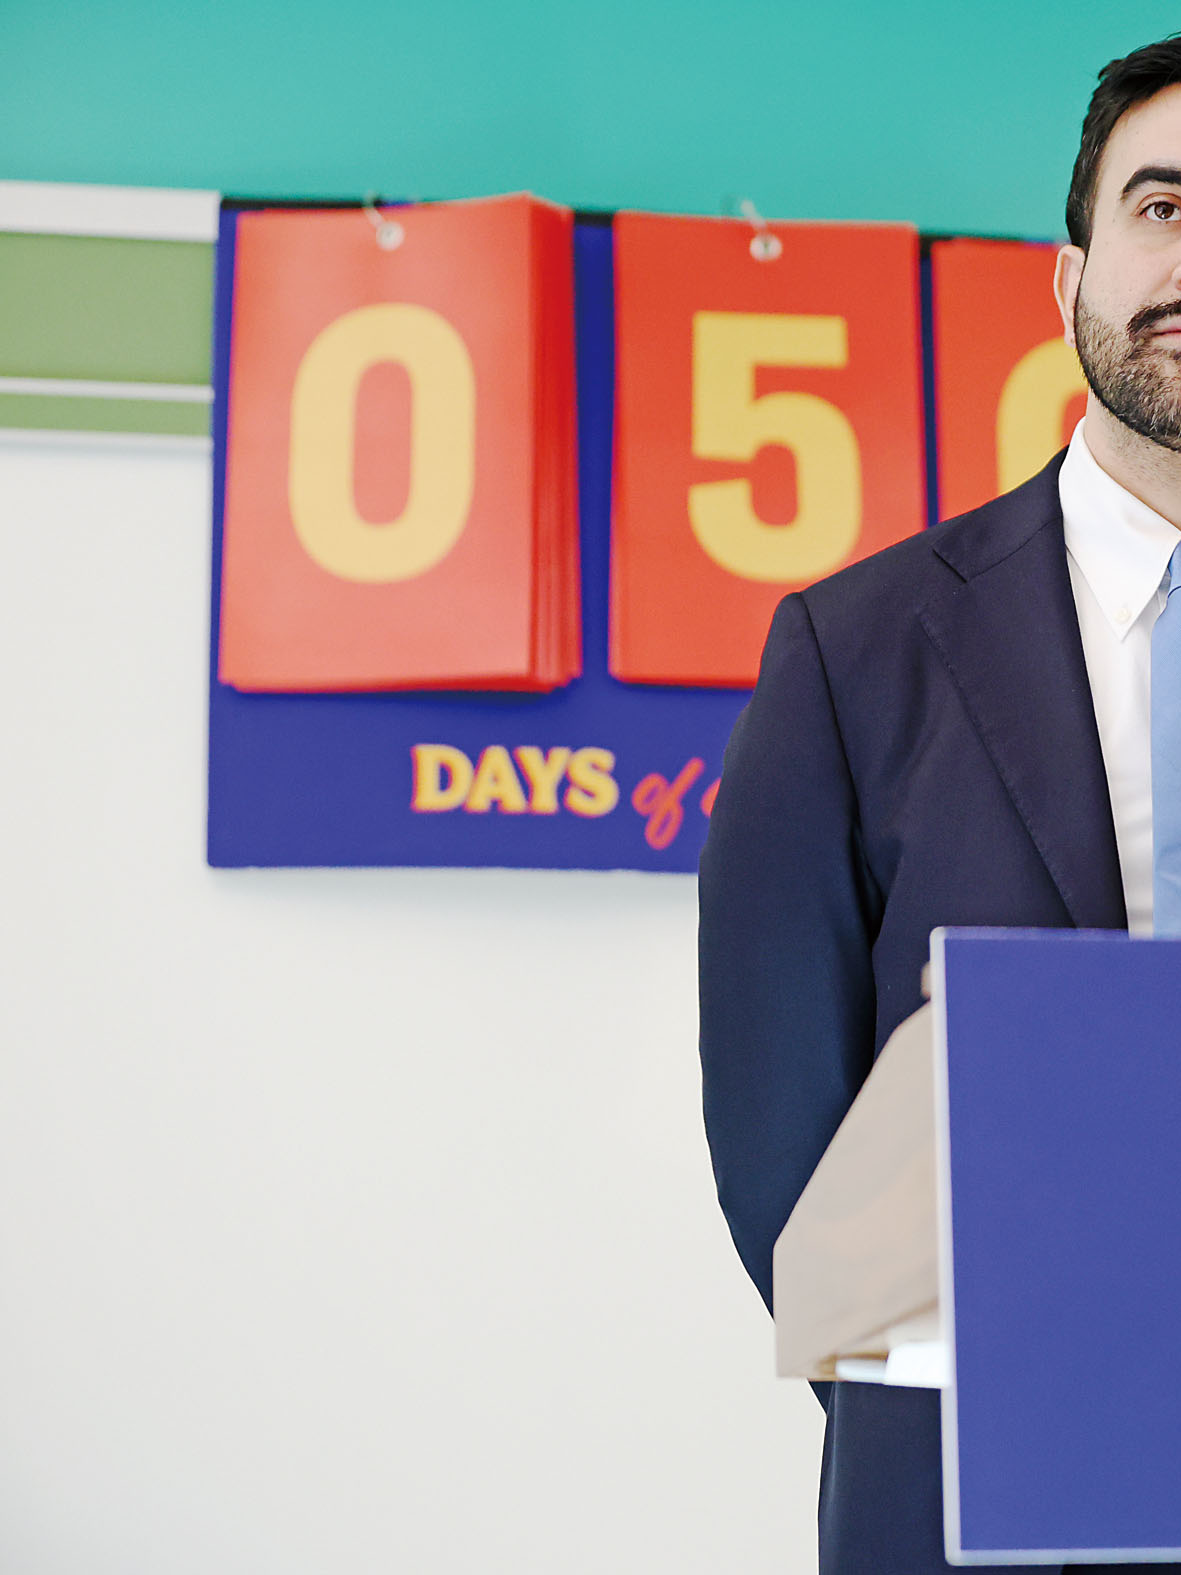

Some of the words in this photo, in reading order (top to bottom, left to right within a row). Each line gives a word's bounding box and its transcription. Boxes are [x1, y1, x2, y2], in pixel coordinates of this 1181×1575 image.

[289, 302, 476, 582] 0
[688, 310, 862, 583] 5
[411, 744, 619, 818] DAYS
[632, 757, 705, 850] of
